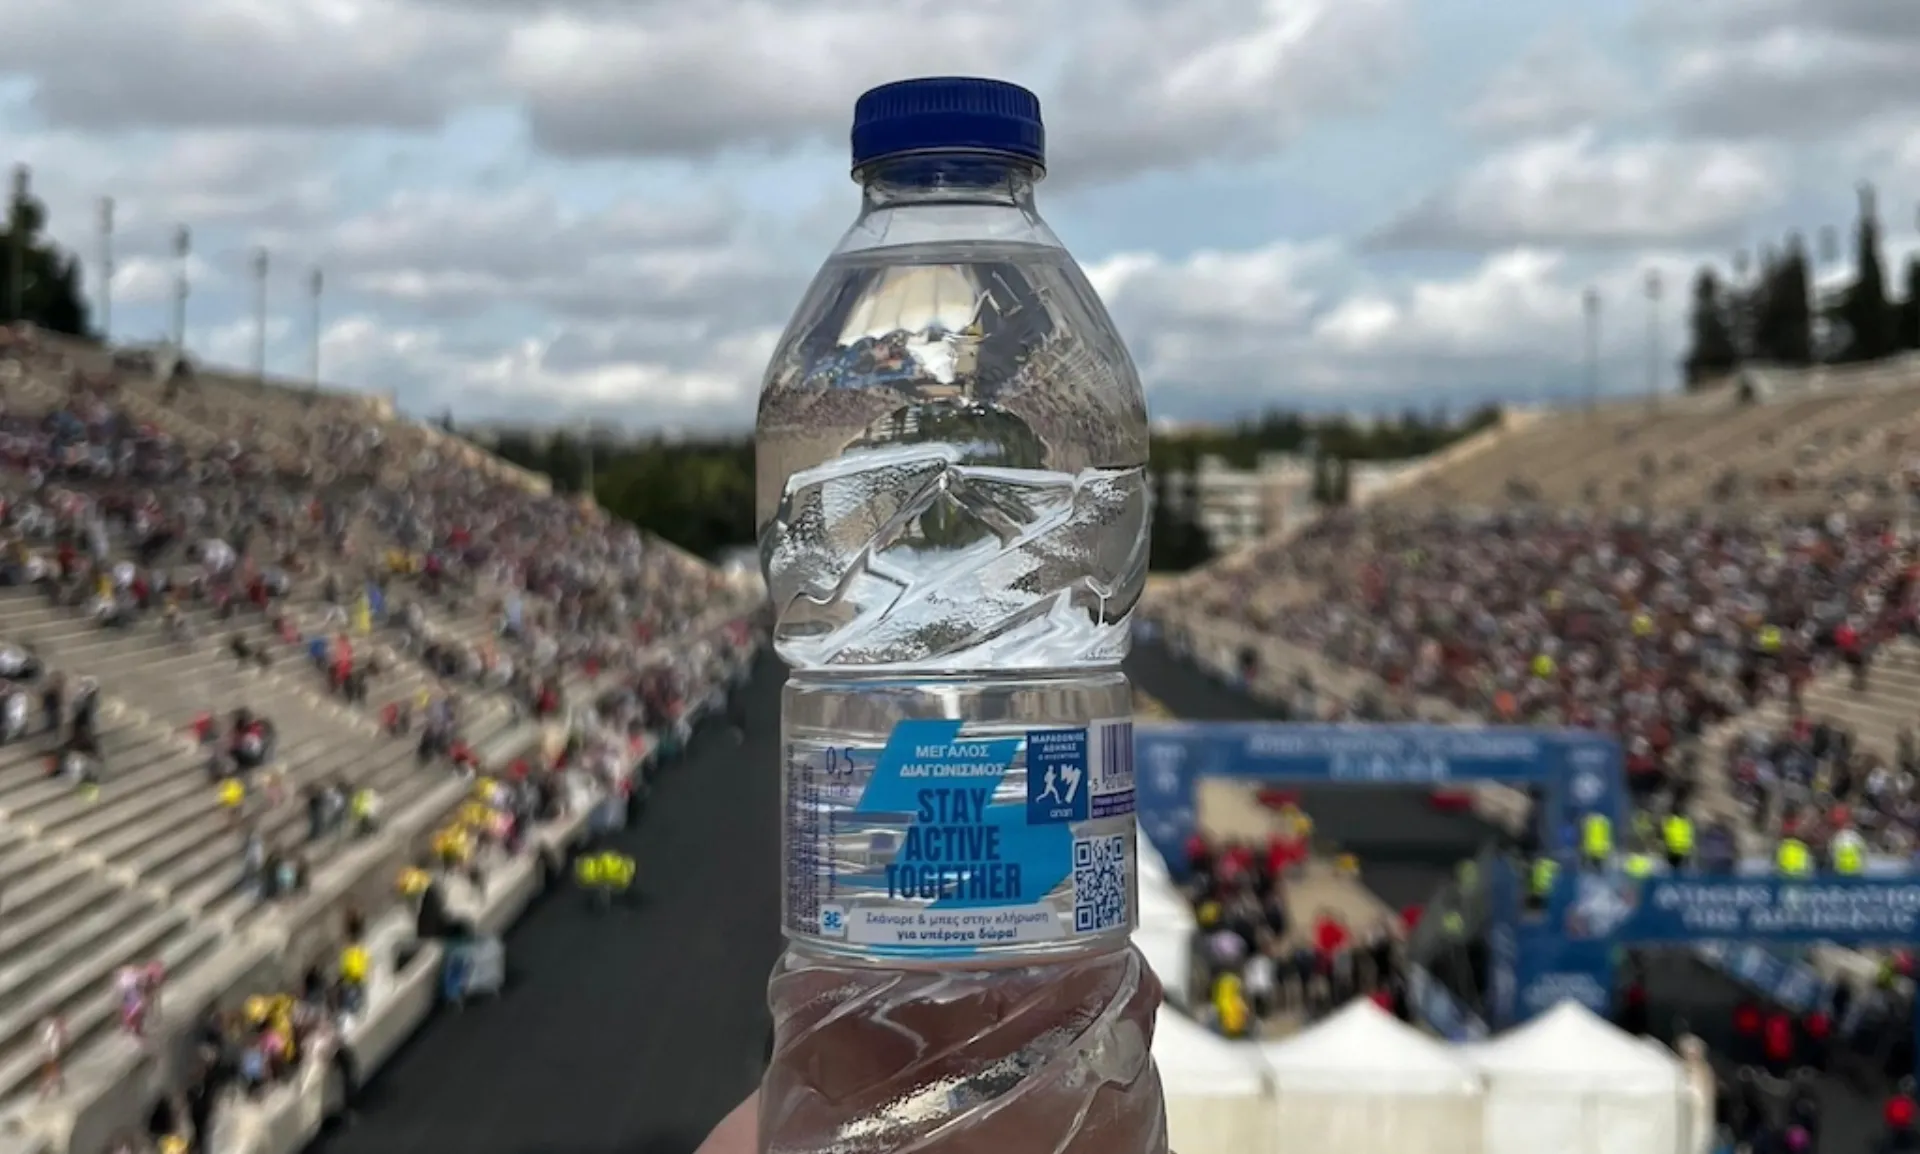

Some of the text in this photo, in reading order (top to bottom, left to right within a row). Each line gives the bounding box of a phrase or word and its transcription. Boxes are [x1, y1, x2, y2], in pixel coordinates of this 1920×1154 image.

[826, 746, 854, 779] 0,5
[915, 745, 990, 758] ΜΕΓΑΛΟΣ
[900, 763, 1006, 777] ΔΙΑΓΩΝΙΣΜΟΣ
[917, 788, 987, 824] STAY
[905, 825, 1000, 861] ACTIVE
[885, 863, 1022, 900] TOGETHER
[918, 913, 926, 925] &
[963, 914, 991, 925] στην
[896, 929, 917, 940] για
